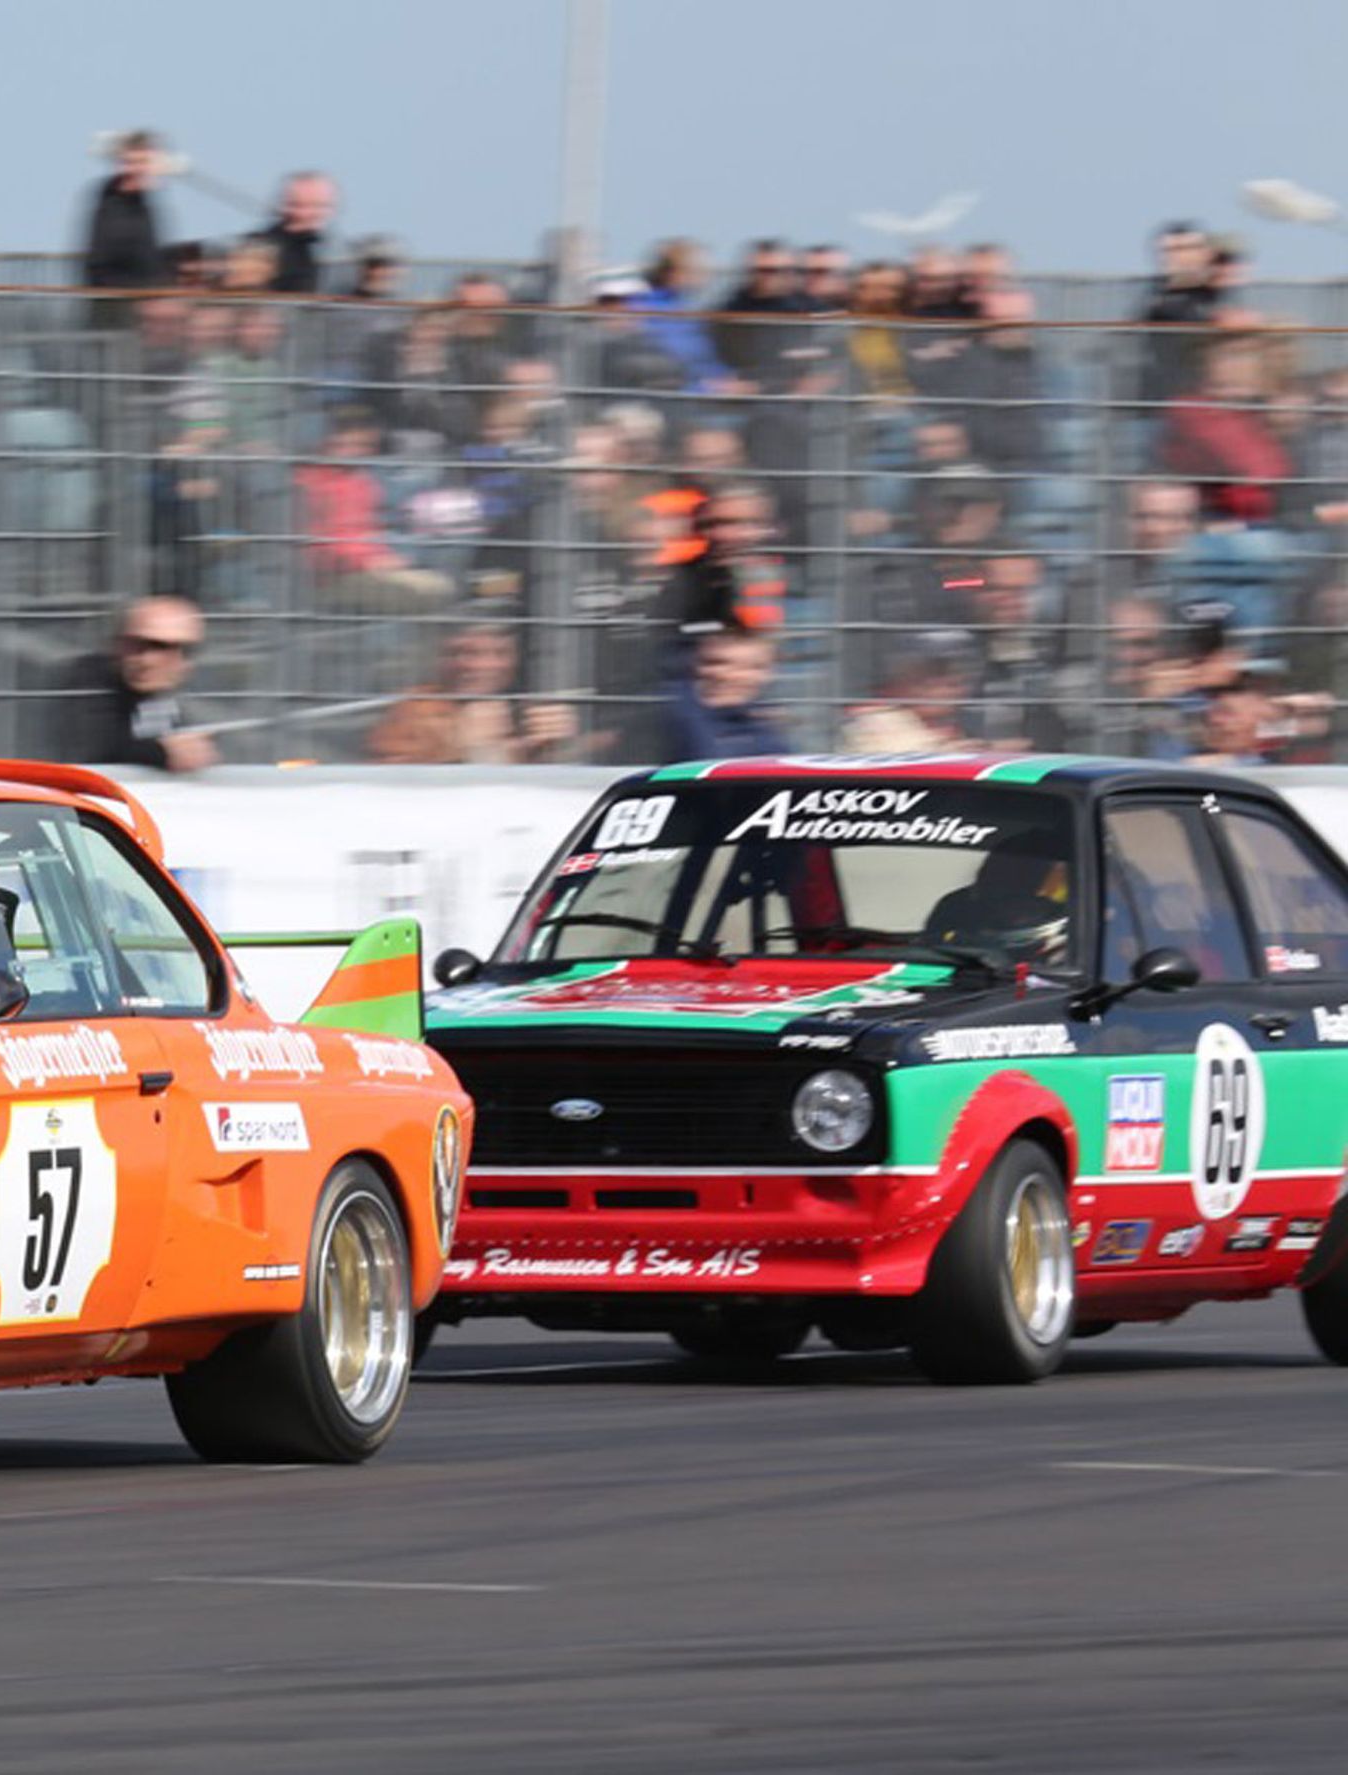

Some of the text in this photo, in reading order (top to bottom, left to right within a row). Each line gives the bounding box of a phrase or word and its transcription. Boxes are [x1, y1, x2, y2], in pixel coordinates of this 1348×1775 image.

[593, 795, 677, 850] 69
[1205, 1058, 1249, 1185] 69
[23, 1148, 82, 1291] 57
[614, 1248, 638, 1275] &
[695, 1248, 762, 1277] A/S
